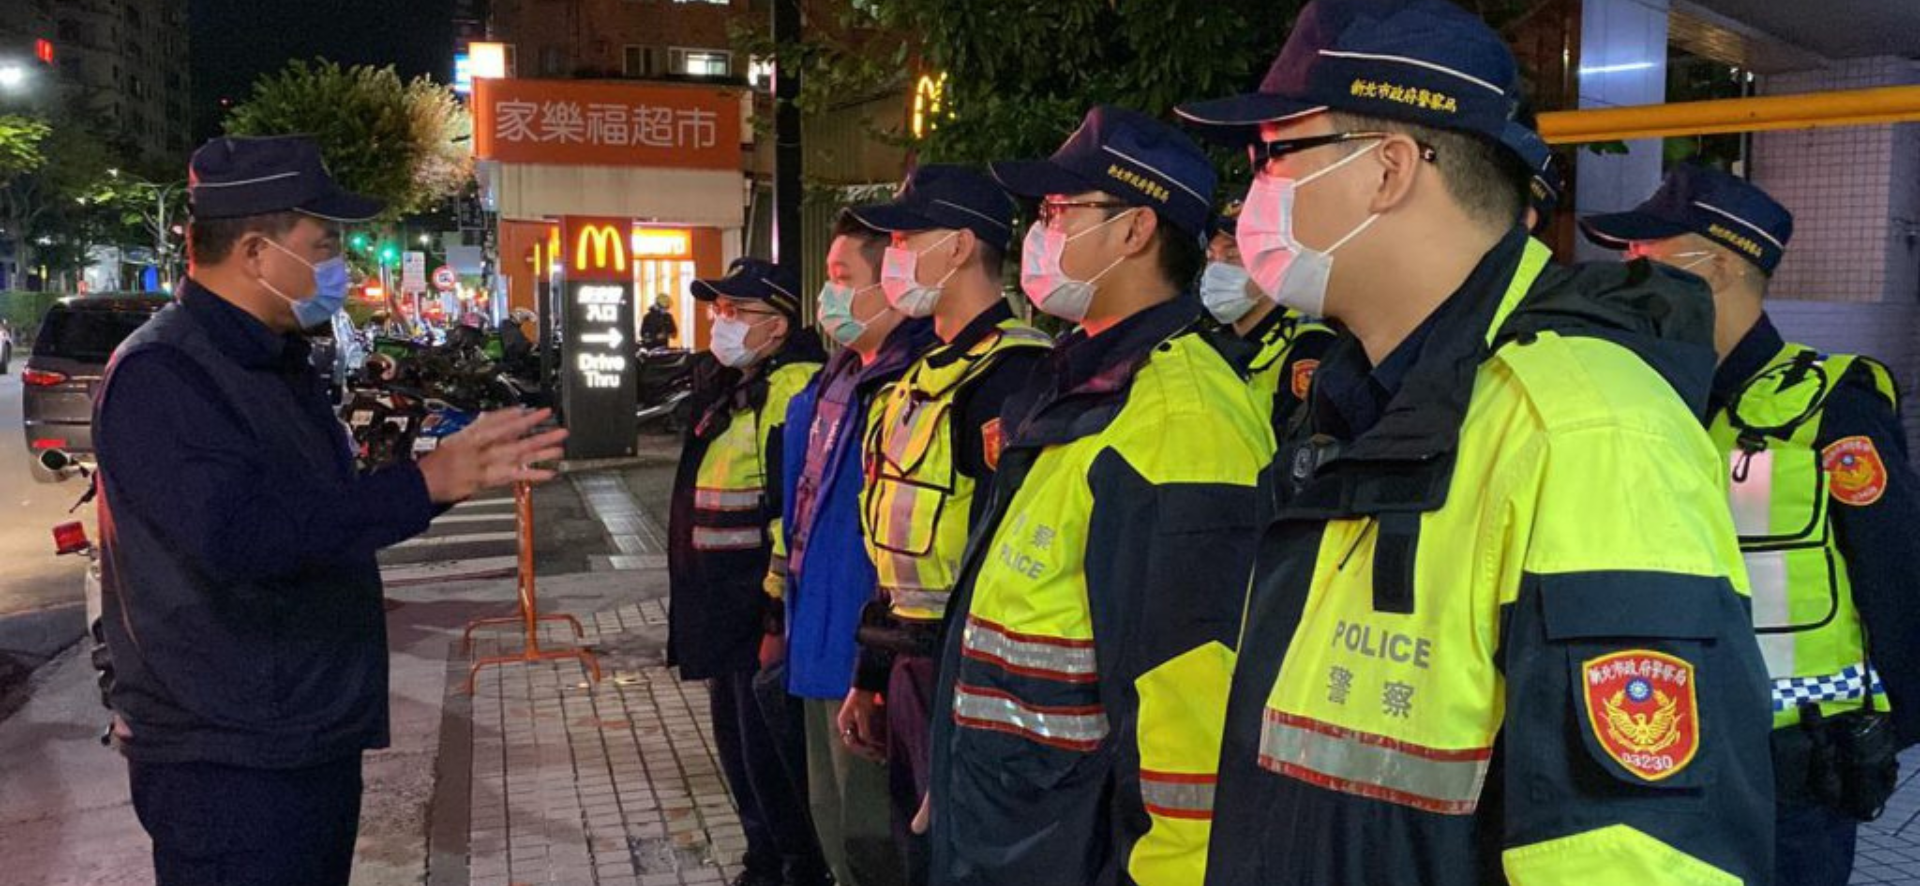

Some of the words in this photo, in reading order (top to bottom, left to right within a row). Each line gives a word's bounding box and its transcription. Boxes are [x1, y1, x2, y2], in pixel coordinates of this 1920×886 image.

[1350, 79, 1457, 112] 新北市政府警察局
[494, 97, 717, 149] 家樂福超市
[586, 304, 618, 322] 入口
[577, 353, 626, 371] Drive
[584, 371, 620, 388] Thru
[1331, 620, 1432, 670] POLICE
[1588, 658, 1687, 688] 新北市政府警察局
[1621, 752, 1673, 771] 03230
